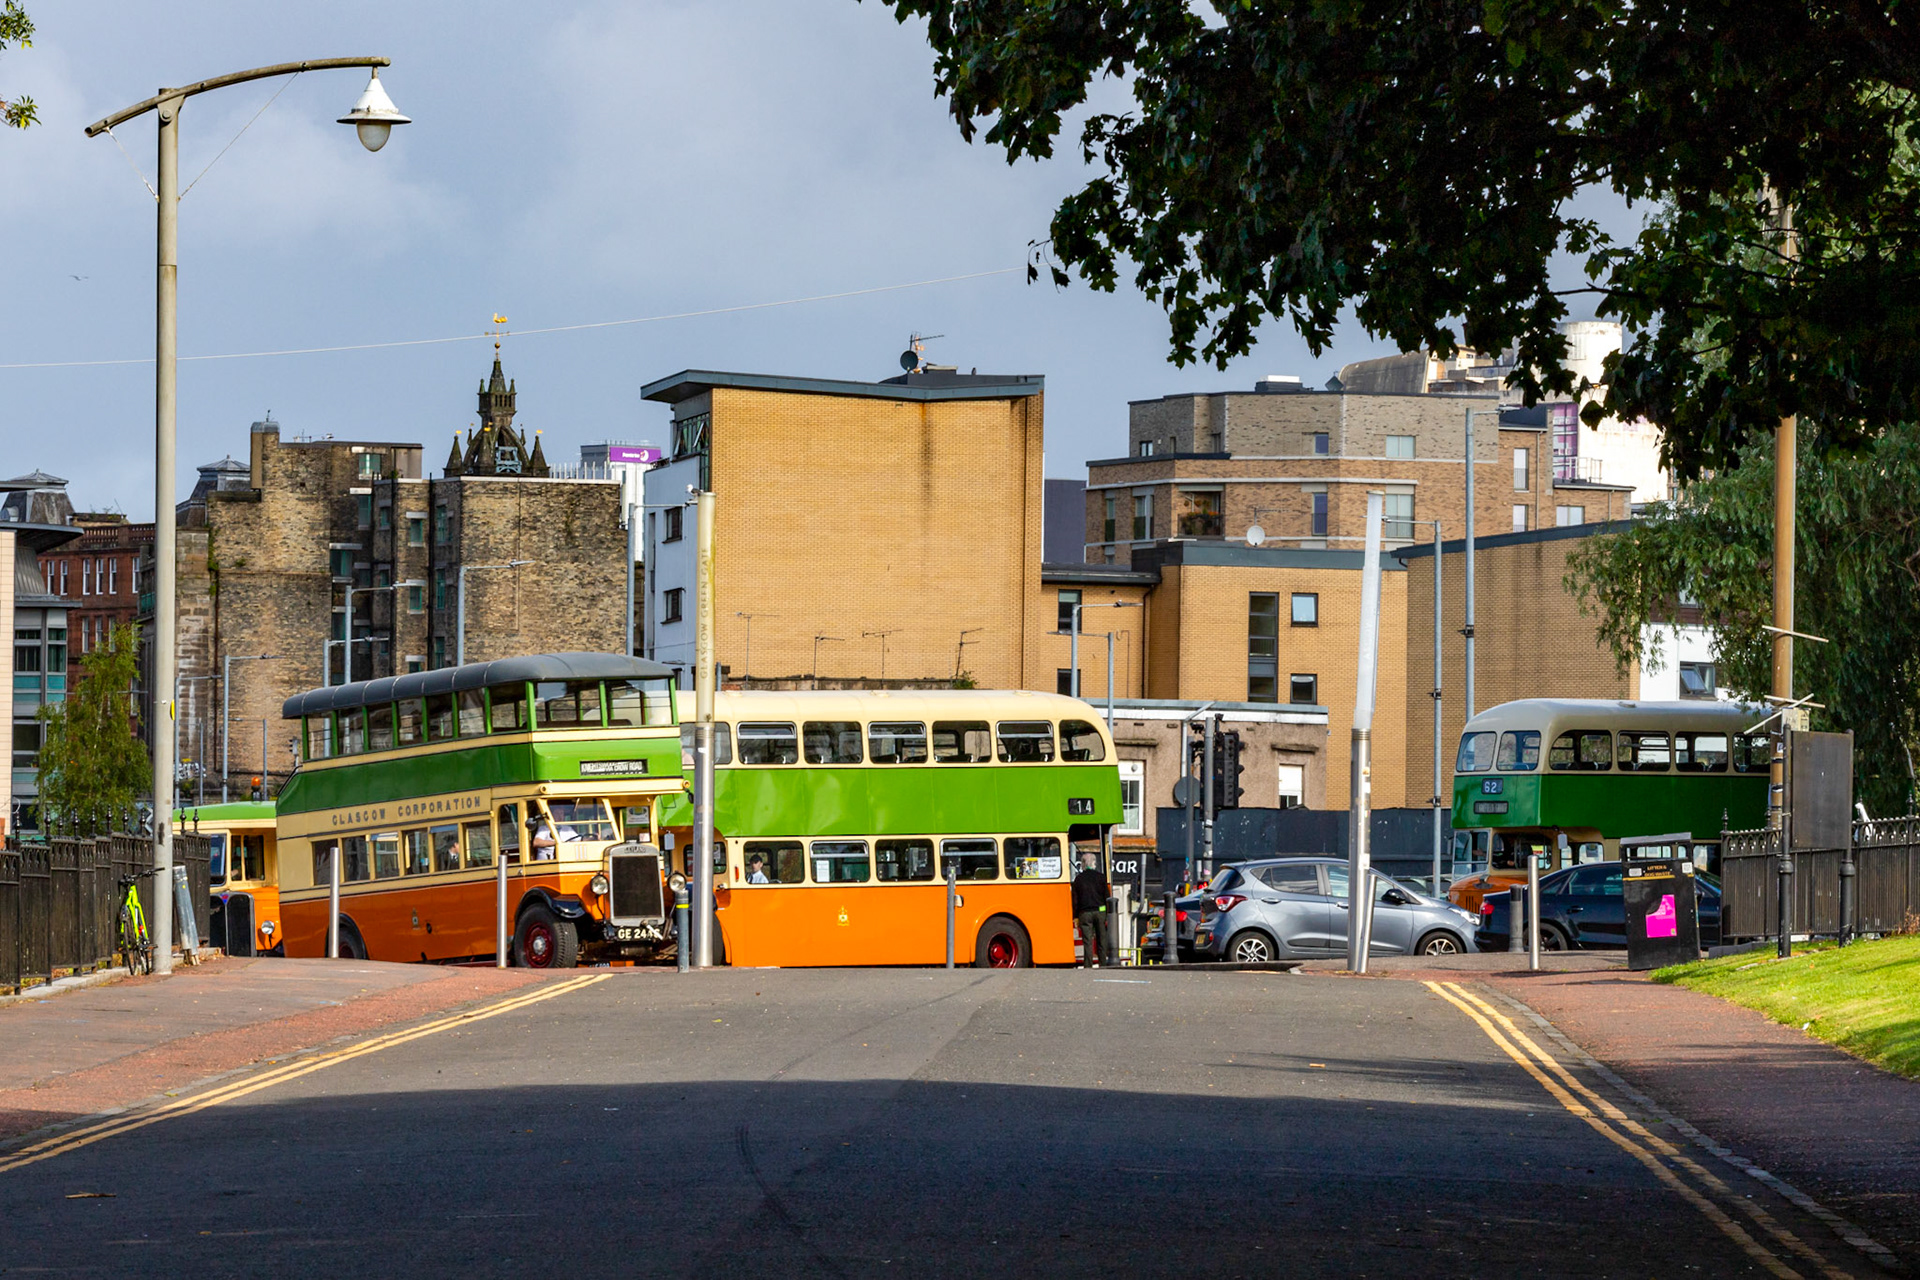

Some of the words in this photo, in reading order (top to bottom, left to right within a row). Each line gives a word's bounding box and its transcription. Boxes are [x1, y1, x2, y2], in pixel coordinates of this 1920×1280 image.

[700, 548, 708, 575] GATE
[700, 580, 708, 618] GREEN
[700, 623, 708, 679] GLASGOW
[1484, 781, 1497, 793] 62
[332, 808, 386, 826] GLASGOW
[398, 796, 481, 817] CORPORATION
[1077, 800, 1092, 814] 14
[618, 928, 632, 939] GE
